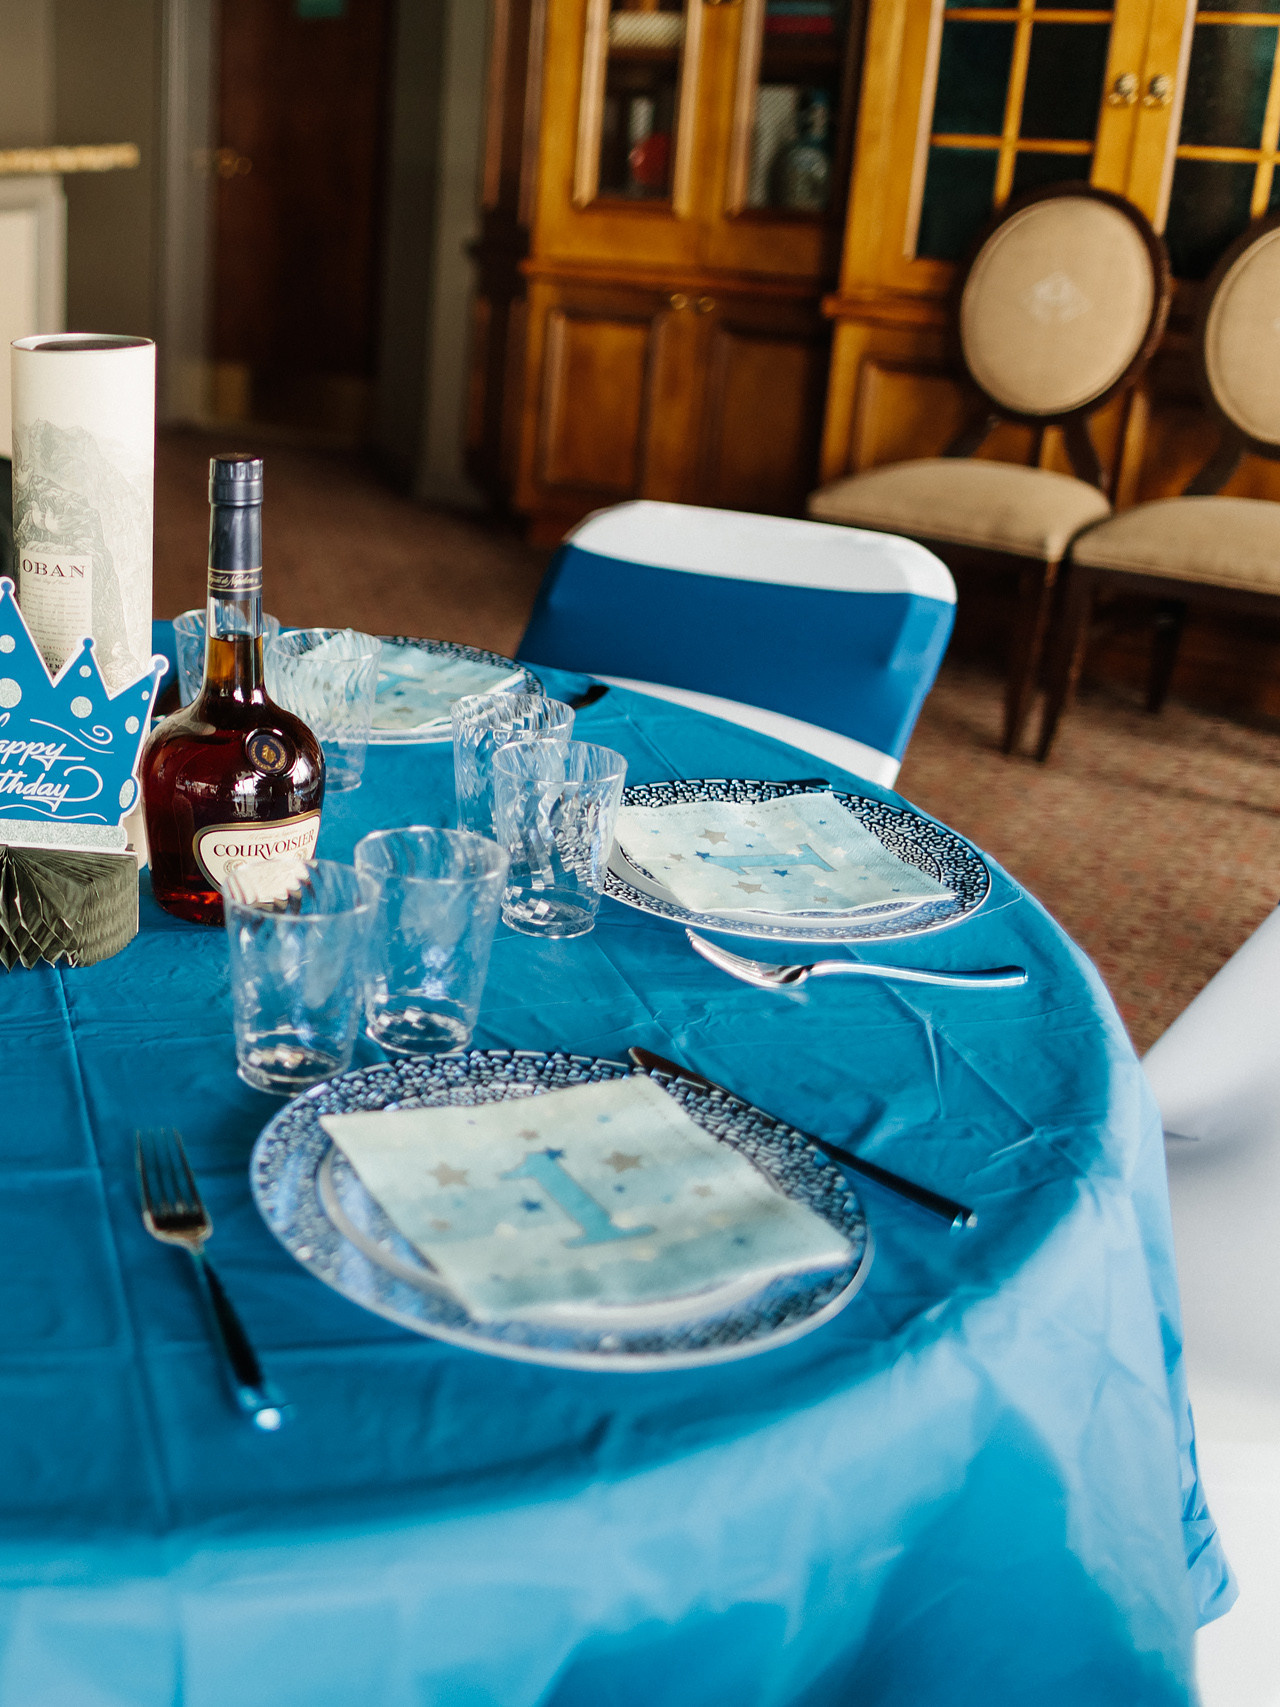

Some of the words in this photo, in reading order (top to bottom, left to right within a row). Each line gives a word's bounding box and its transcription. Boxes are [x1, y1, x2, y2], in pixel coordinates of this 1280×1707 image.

[22, 559, 86, 578] OBAN
[213, 828, 316, 861] COURVOISIER
[499, 1150, 657, 1249] 1
